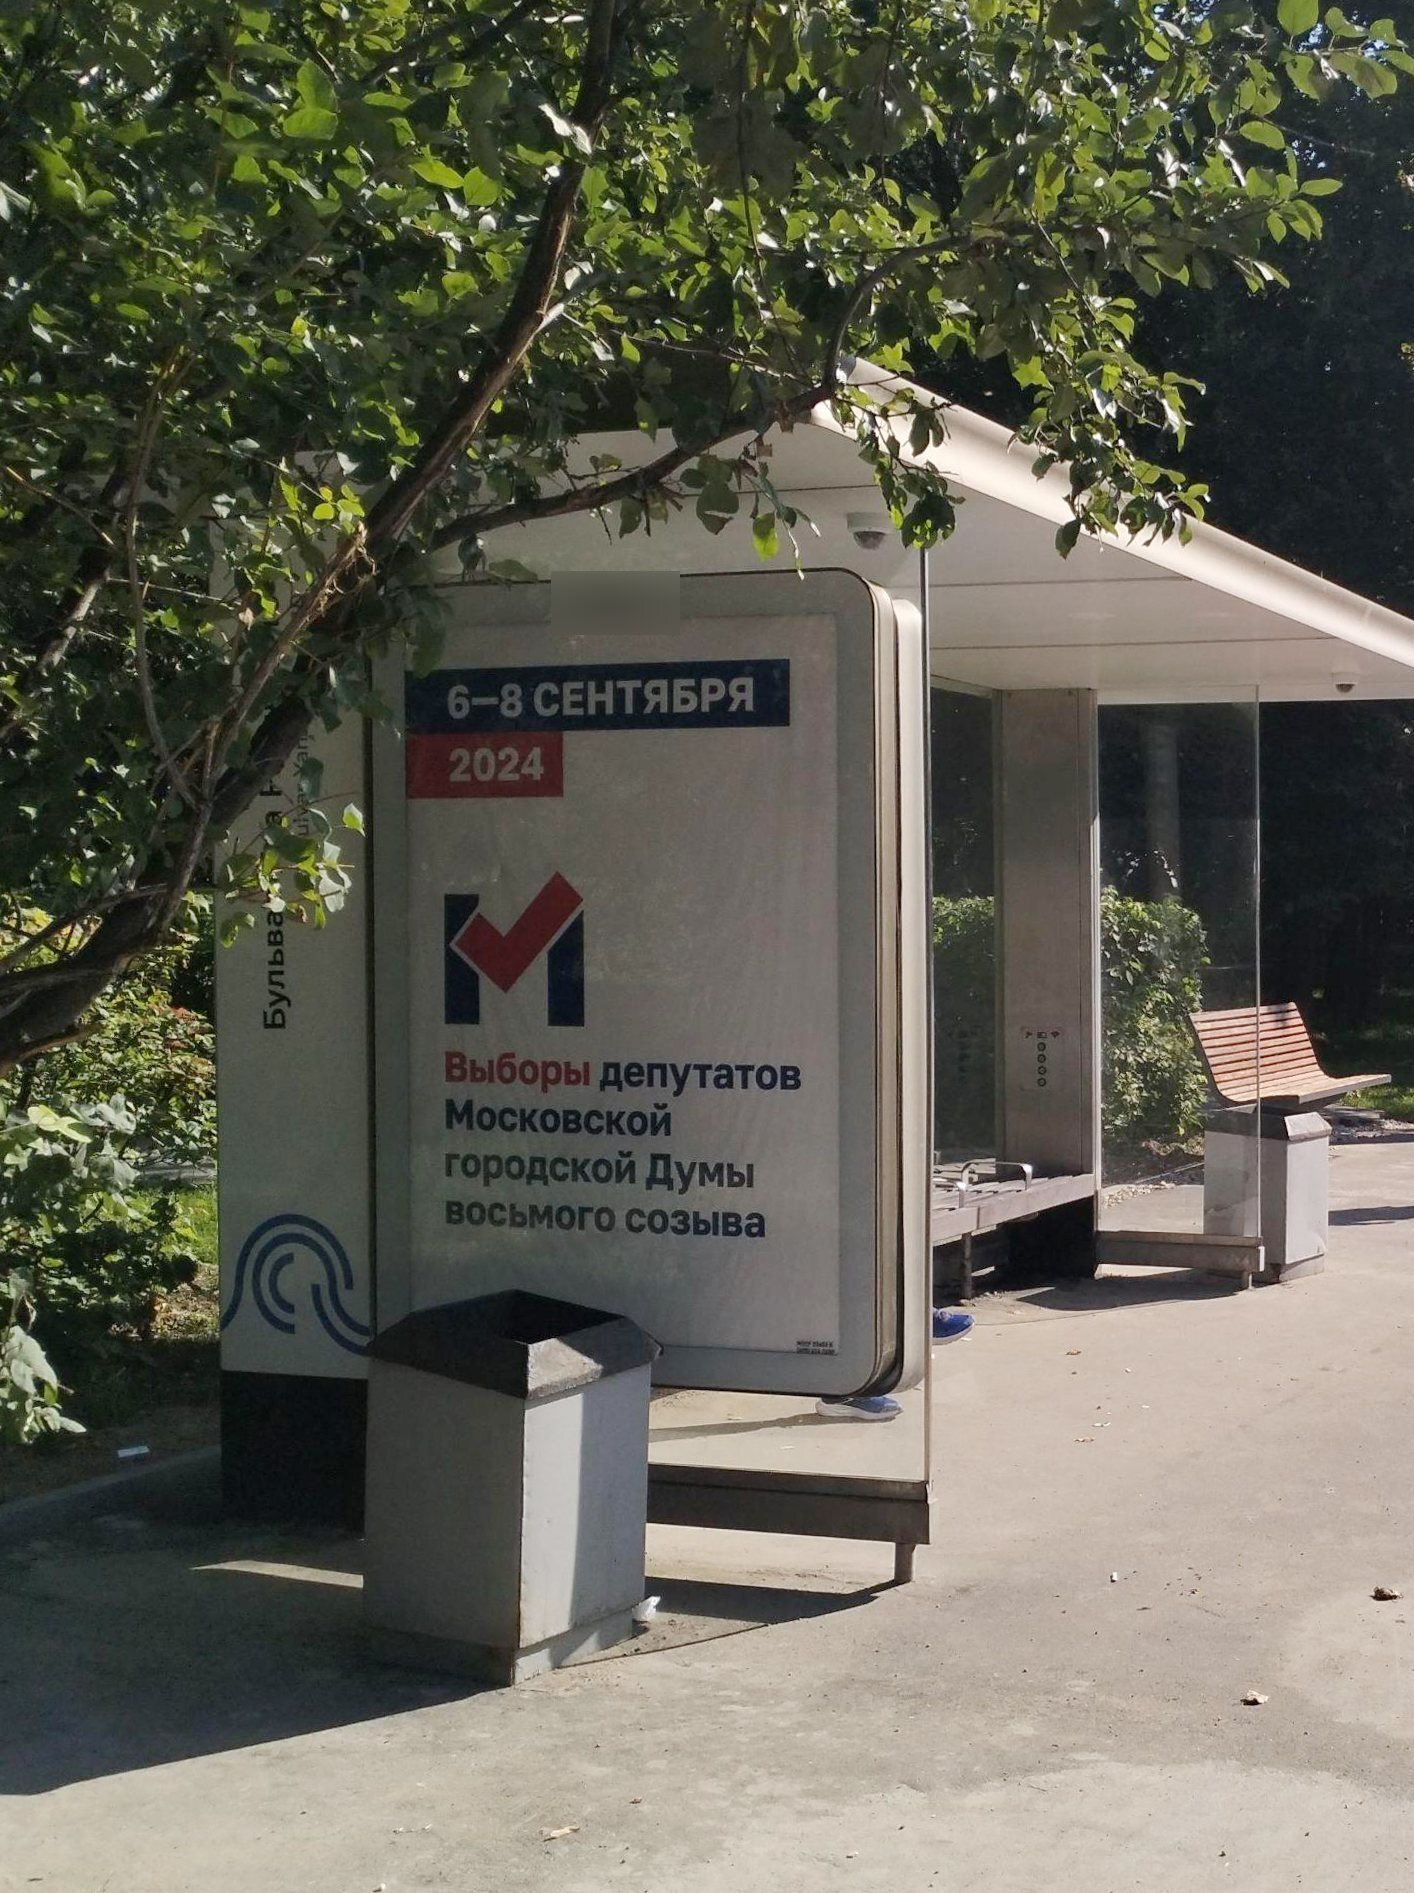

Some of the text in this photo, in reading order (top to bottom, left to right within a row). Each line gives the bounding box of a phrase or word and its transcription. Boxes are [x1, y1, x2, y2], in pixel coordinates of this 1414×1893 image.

[533, 676, 755, 717] СЕНТЯБРЯ
[448, 747, 544, 783] 2024
[263, 898, 291, 1030] Бульва
[444, 1050, 802, 1096] Выборы депутатов
[444, 1098, 672, 1137] Московской
[444, 1150, 755, 1195] городской Думы
[445, 1201, 766, 1239] восьмого созыва
